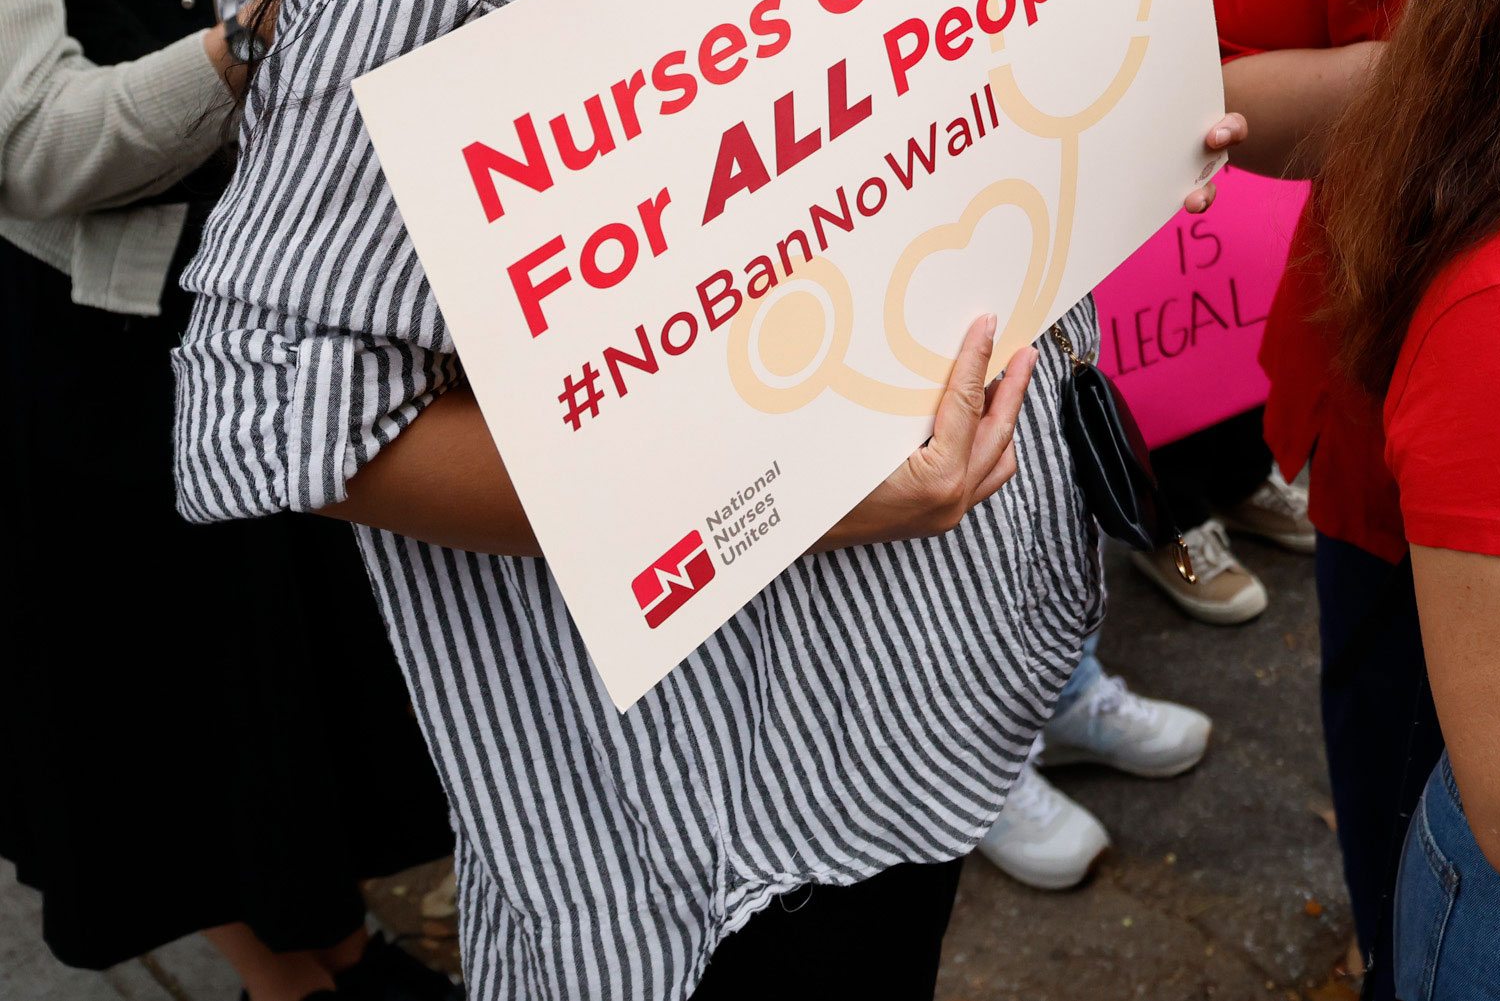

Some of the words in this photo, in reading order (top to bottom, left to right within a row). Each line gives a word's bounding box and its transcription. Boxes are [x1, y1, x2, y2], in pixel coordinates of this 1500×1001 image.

[507, 187, 671, 338] For
[702, 59, 872, 225] ALL
[558, 85, 999, 431] #NoBanNoWall
[1177, 219, 1222, 276] IS
[705, 460, 781, 532] National
[713, 493, 775, 550] Nurses
[720, 508, 781, 566] United
